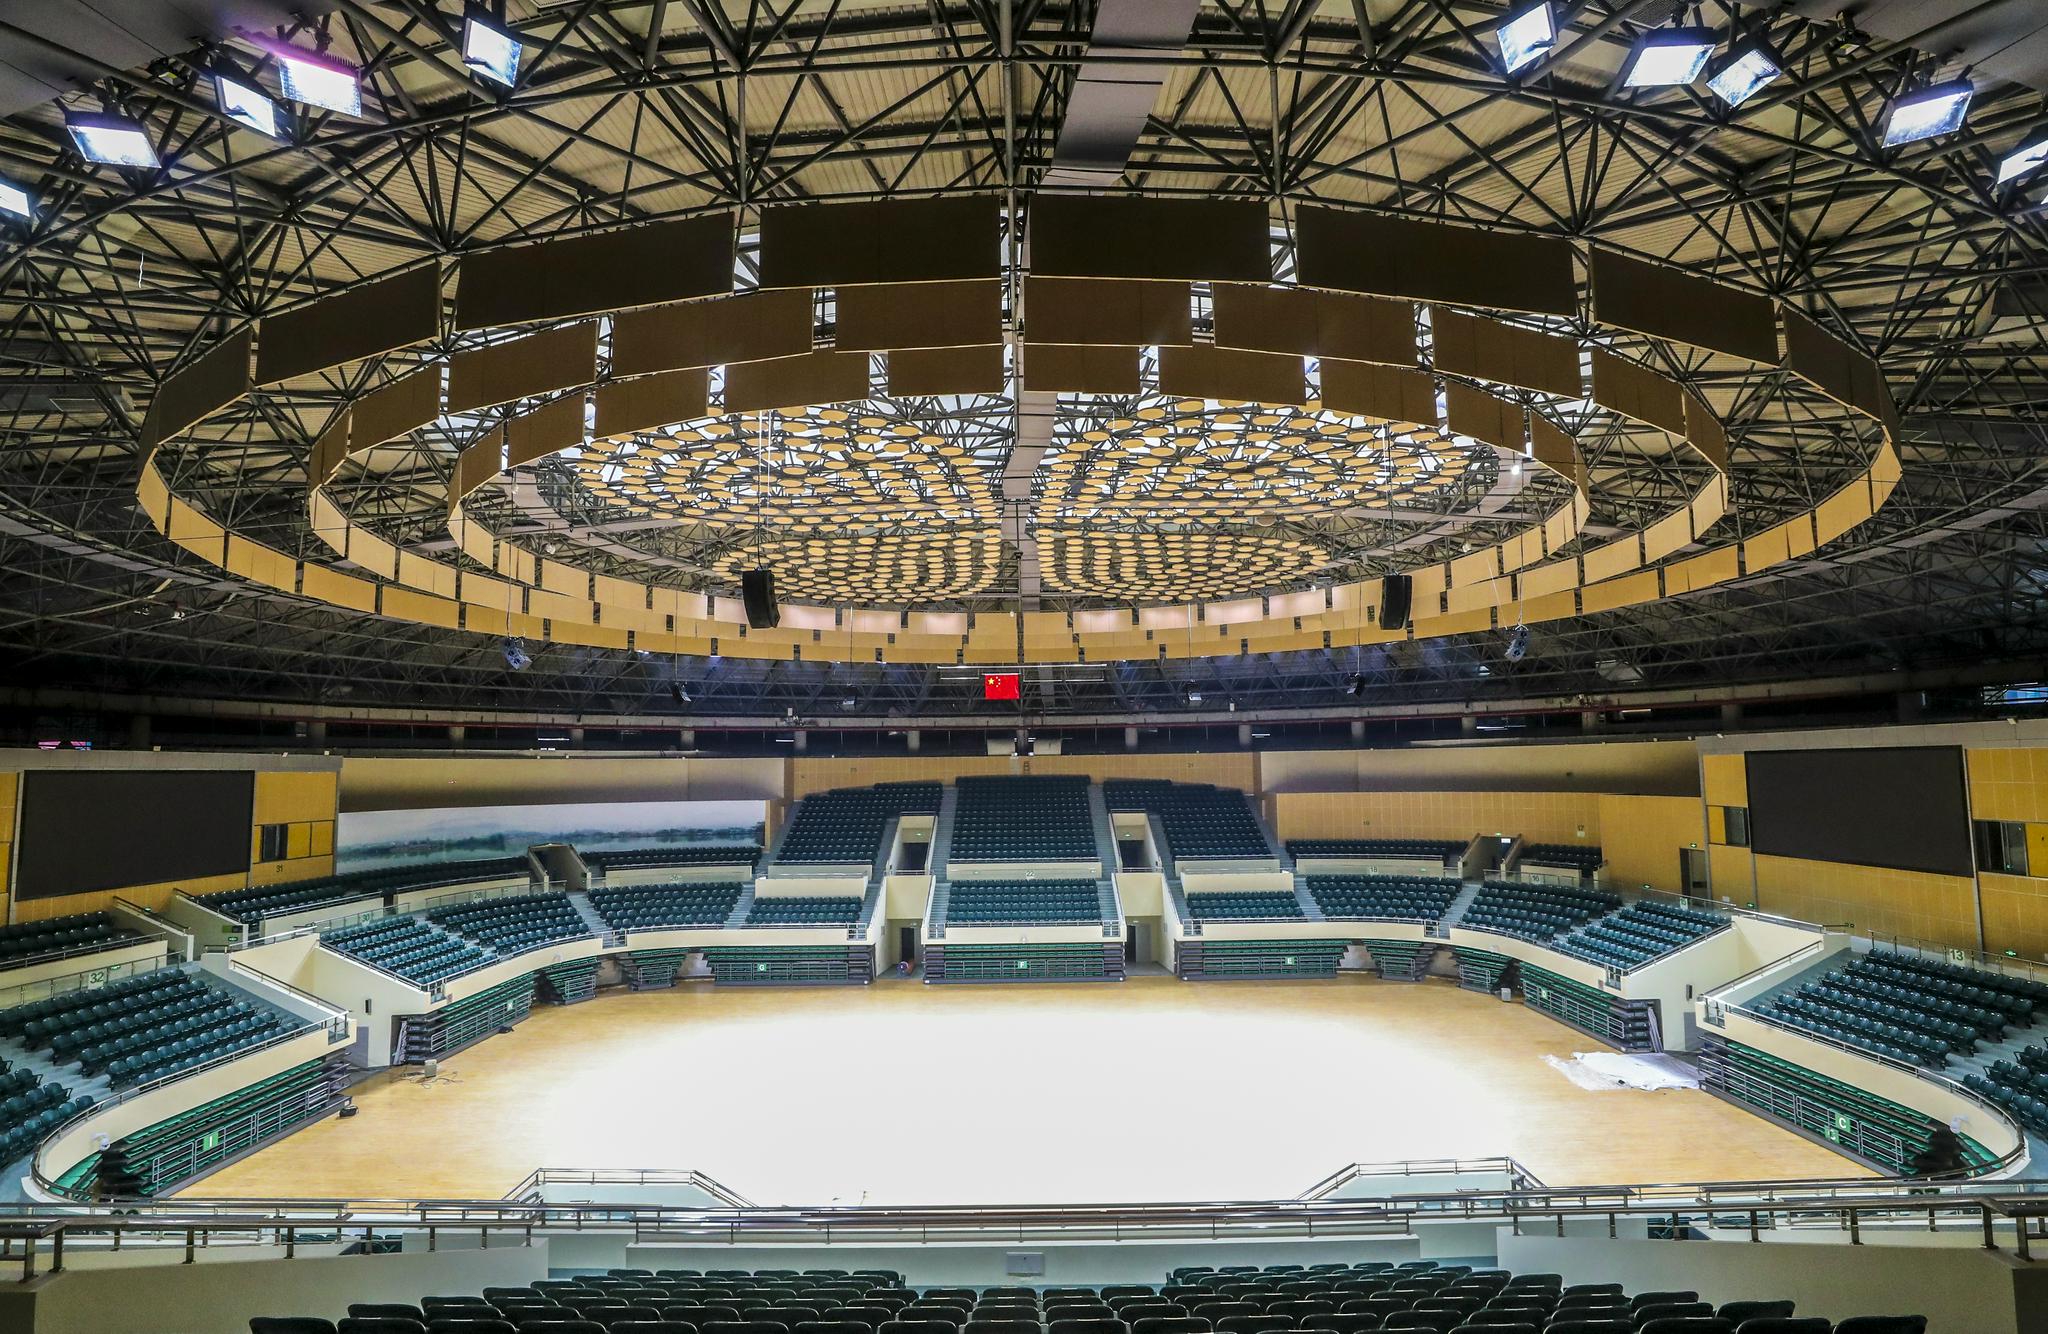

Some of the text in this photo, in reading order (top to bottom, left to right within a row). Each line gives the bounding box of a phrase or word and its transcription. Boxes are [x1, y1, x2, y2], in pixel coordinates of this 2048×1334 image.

[1950, 949, 1964, 961] 13
[90, 972, 104, 984] 32
[1838, 1117, 1846, 1128] C
